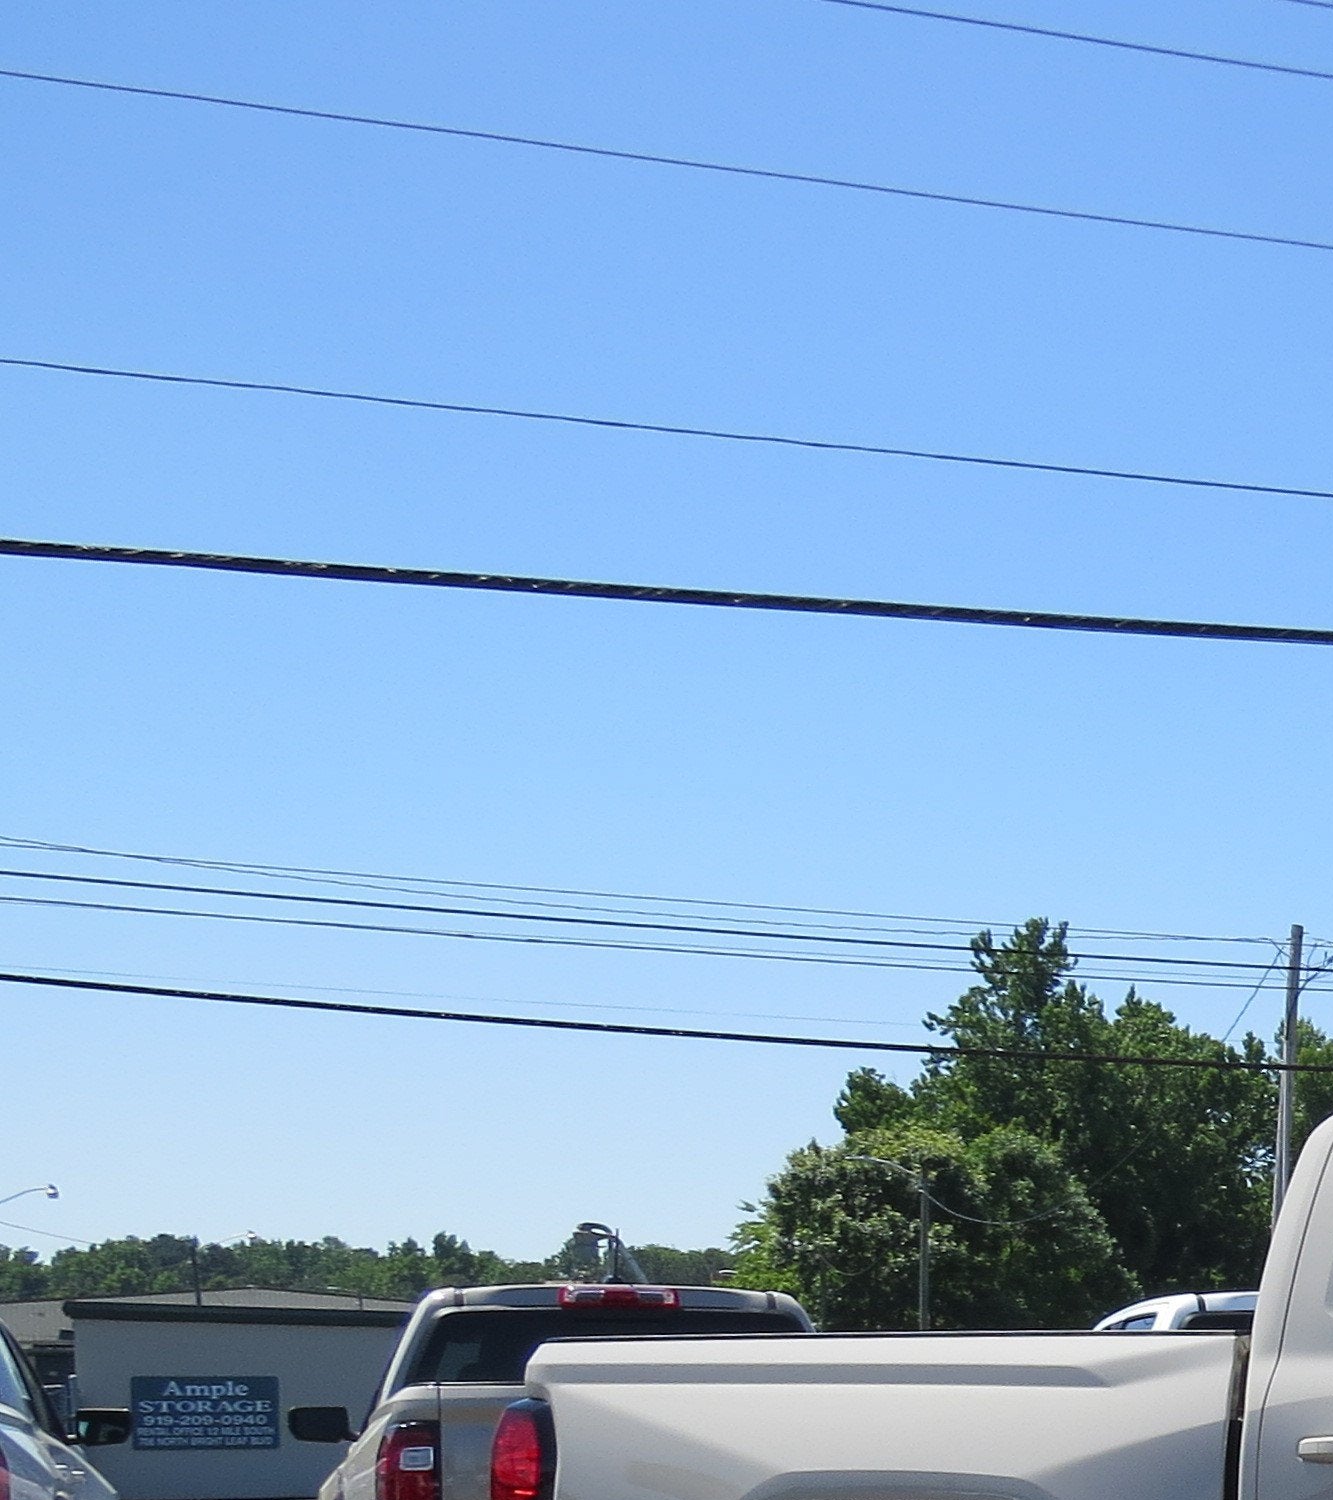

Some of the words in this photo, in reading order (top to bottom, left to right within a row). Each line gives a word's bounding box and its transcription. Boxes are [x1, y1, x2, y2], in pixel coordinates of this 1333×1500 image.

[163, 1381, 250, 1399] Ample
[139, 1400, 274, 1413] STORAGE
[142, 1414, 268, 1426] 919-209-0940
